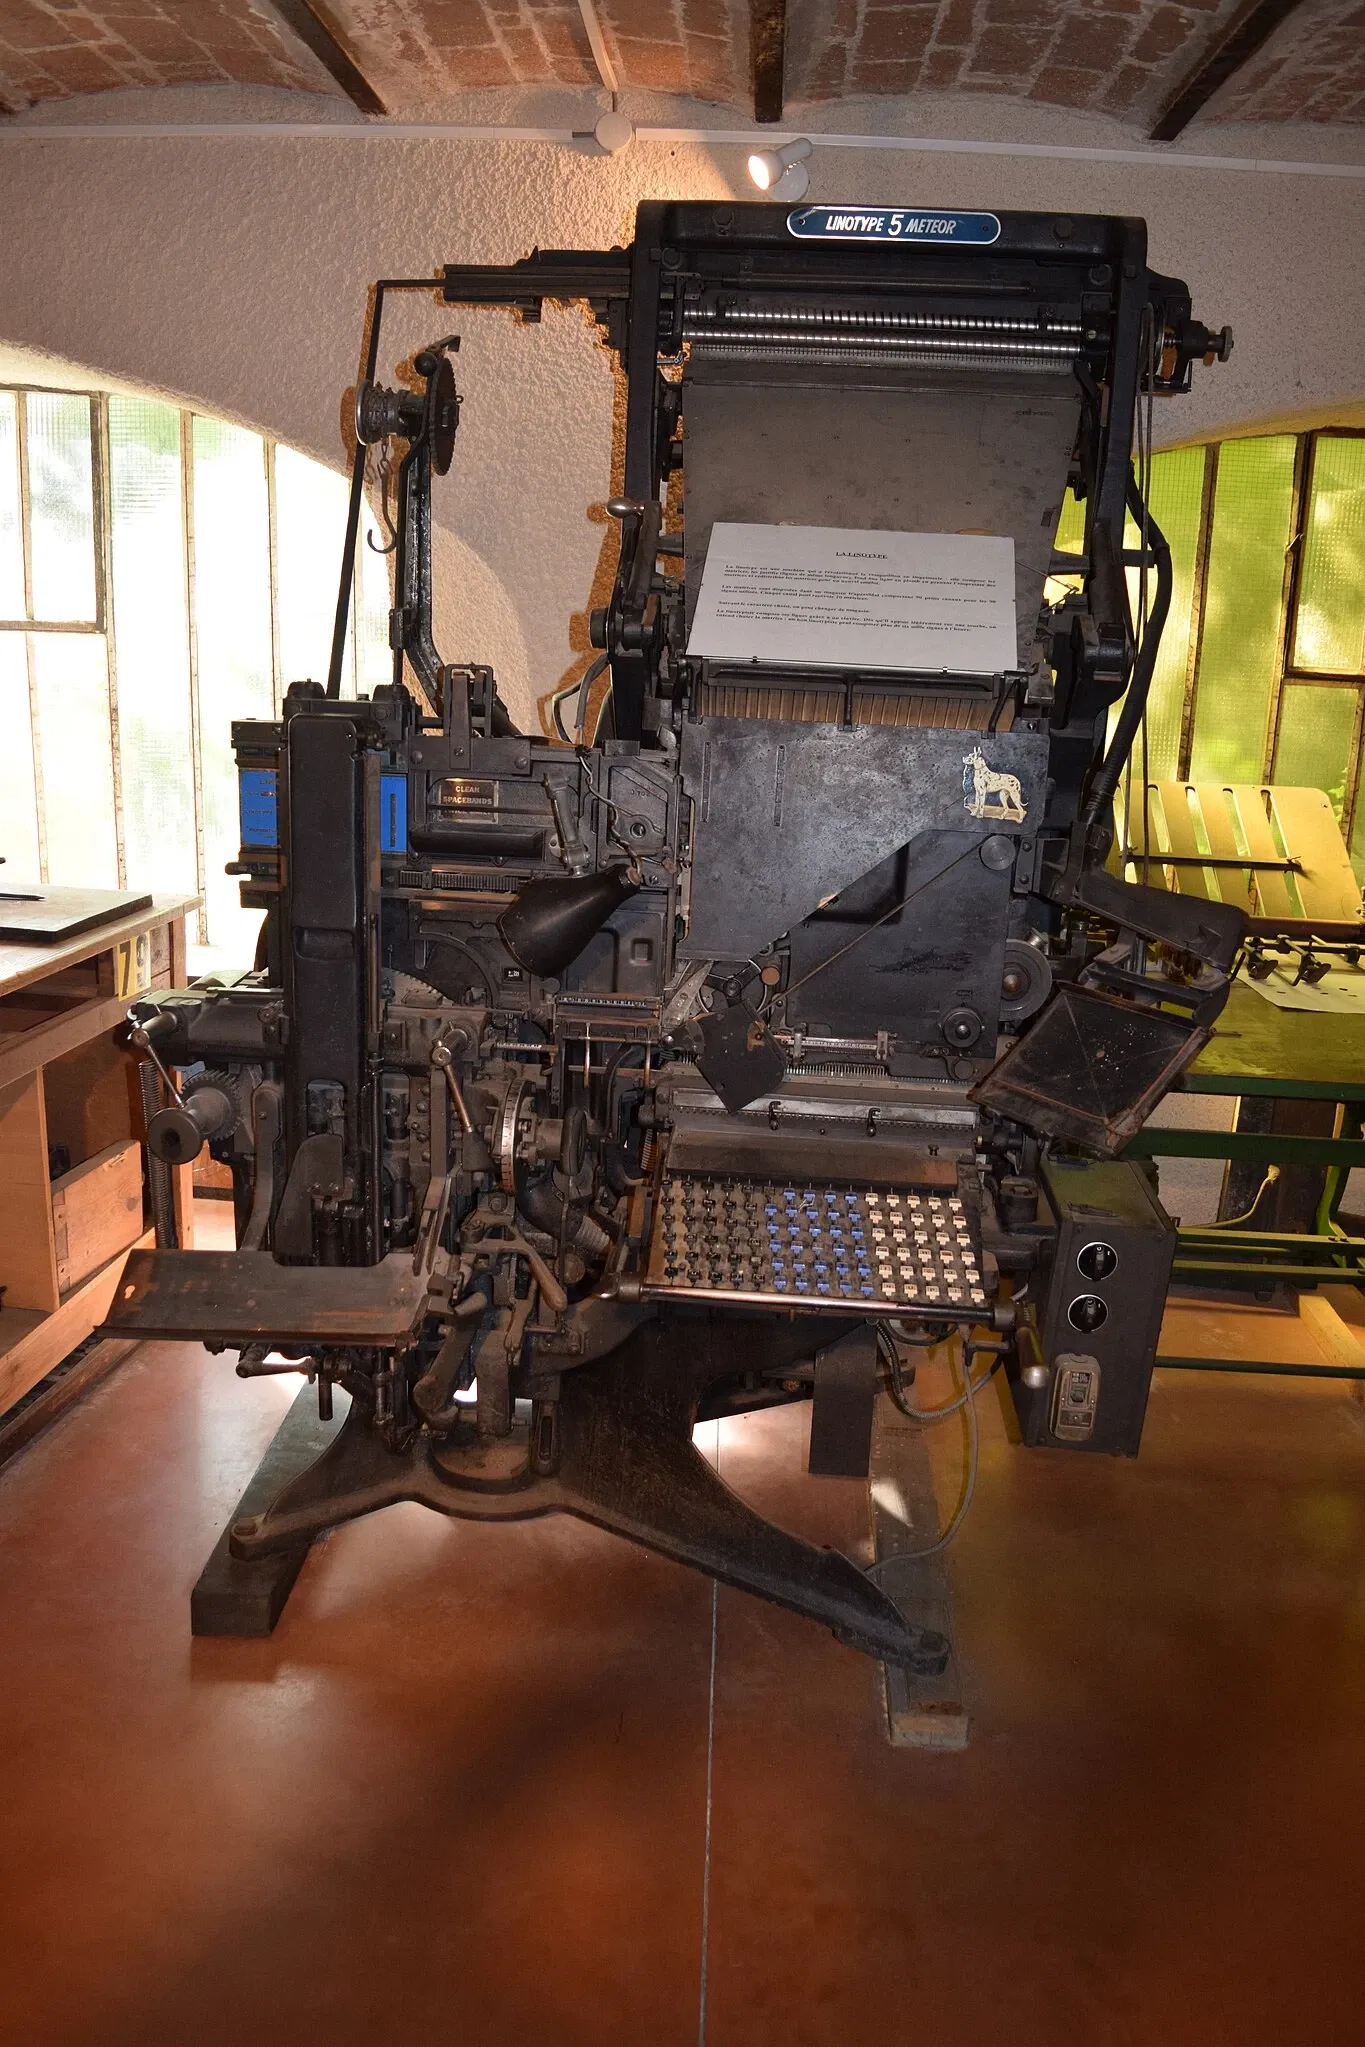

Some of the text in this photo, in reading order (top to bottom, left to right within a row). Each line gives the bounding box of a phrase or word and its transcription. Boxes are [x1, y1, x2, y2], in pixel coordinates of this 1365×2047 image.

[826, 214, 956, 236] LINOTYPE 5 METEOR
[443, 796, 492, 805] SPACEBANDS
